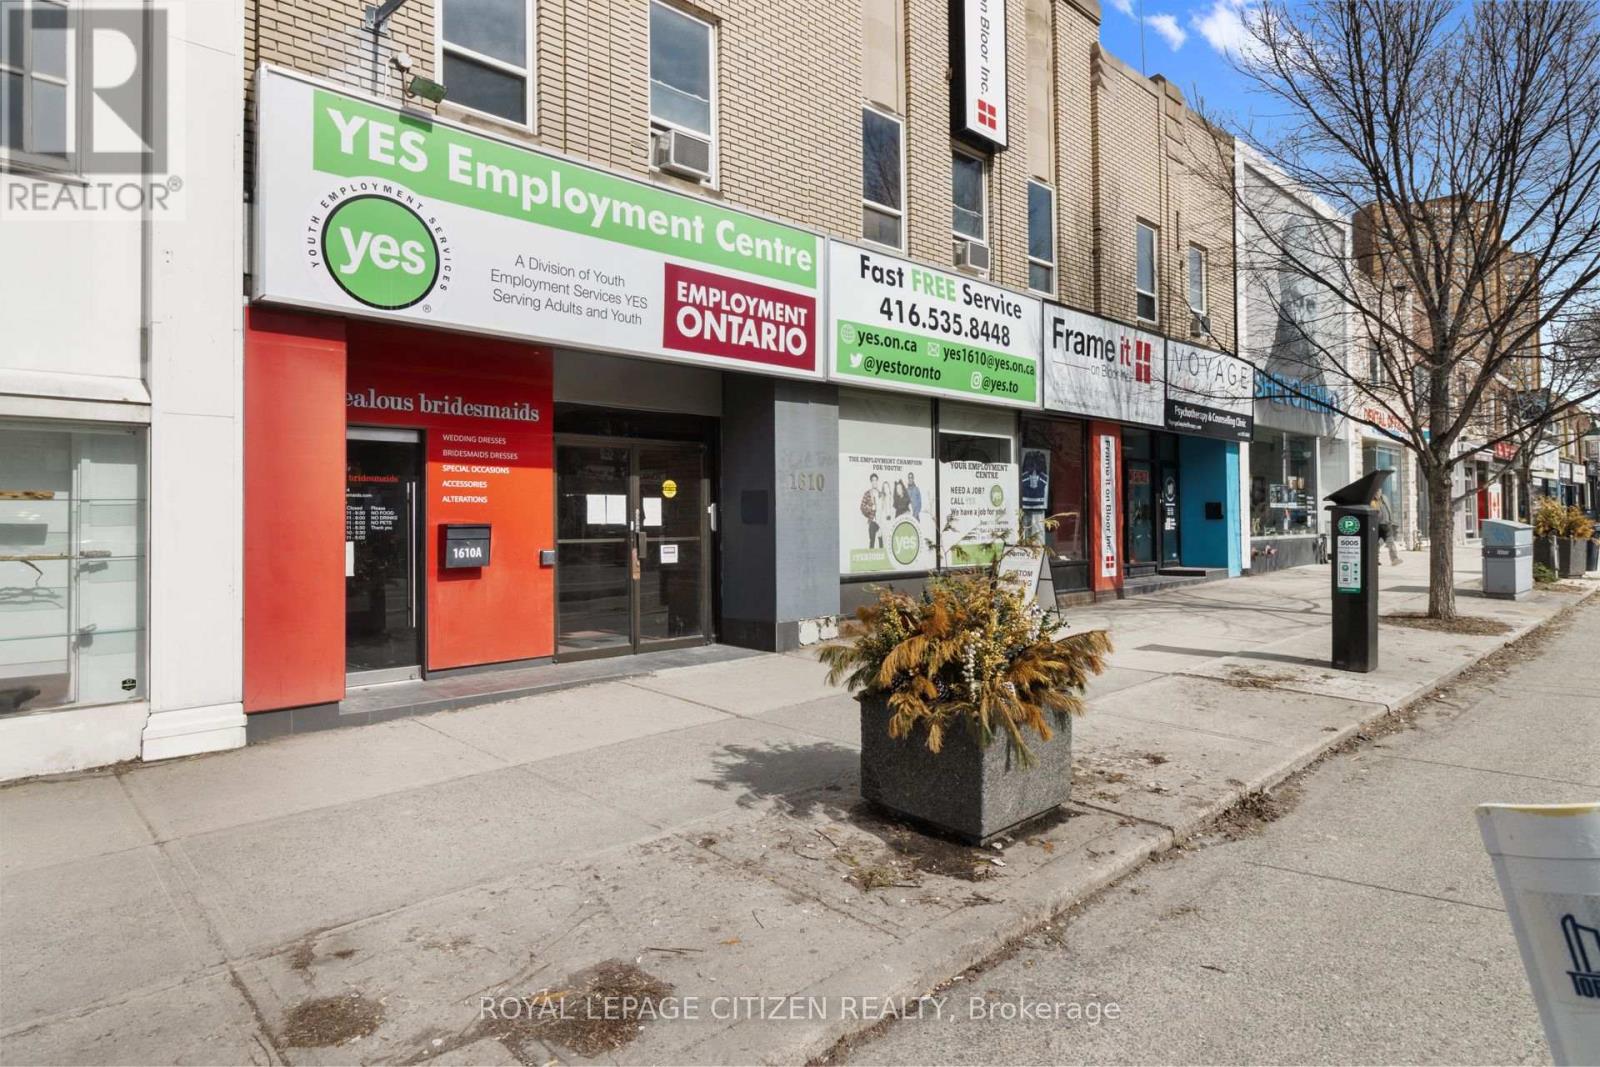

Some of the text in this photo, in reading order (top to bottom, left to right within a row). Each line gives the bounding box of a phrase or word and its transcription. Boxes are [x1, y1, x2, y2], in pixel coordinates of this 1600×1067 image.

[980, 16, 990, 62] Bloor
[980, 66, 990, 95] Inc.
[326, 107, 812, 272] YES Employment Centre
[307, 182, 452, 291] YOUTH EMPLOYMENT SERVICES
[339, 226, 426, 275] yes
[515, 254, 626, 288] A Division of Youth
[491, 268, 648, 309] Employment Services YES
[860, 254, 1022, 319] Fast FREE Service
[492, 288, 642, 325] Serving Adults and Youth
[677, 280, 808, 328] EMPLOYMENT
[676, 310, 808, 356] ONTARIO
[880, 297, 1011, 347] 416.535.8448
[857, 330, 1035, 376] yes.on.ca yes1610@yes.on.ca
[1053, 316, 1131, 367] Frame it
[864, 355, 1019, 394] @yestoronto @yes.to
[1174, 346, 1249, 390] VOYAGE
[418, 393, 540, 422] bridesmaids
[1174, 404, 1208, 423] Psychotherapy
[1208, 412, 1212, 422] &
[442, 434, 507, 445] WEDDING DRESSES
[442, 449, 518, 460] BRIDESMAIDS DRESSES
[442, 464, 510, 474] SPECIAL OCCASIONS
[860, 456, 895, 465] EMPLOYMENT
[950, 462, 1008, 472] YOUR EMPLOYMENT
[442, 480, 488, 488] ACCESSORIES
[789, 471, 825, 491] 1610
[950, 486, 966, 494] NEED
[972, 487, 985, 495] JOB?
[1105, 488, 1111, 502] on
[442, 495, 488, 503] ALTERATIONS
[978, 508, 986, 517] job
[1344, 520, 1354, 530] P
[452, 547, 482, 559] 1610A
[895, 535, 916, 553] yes
